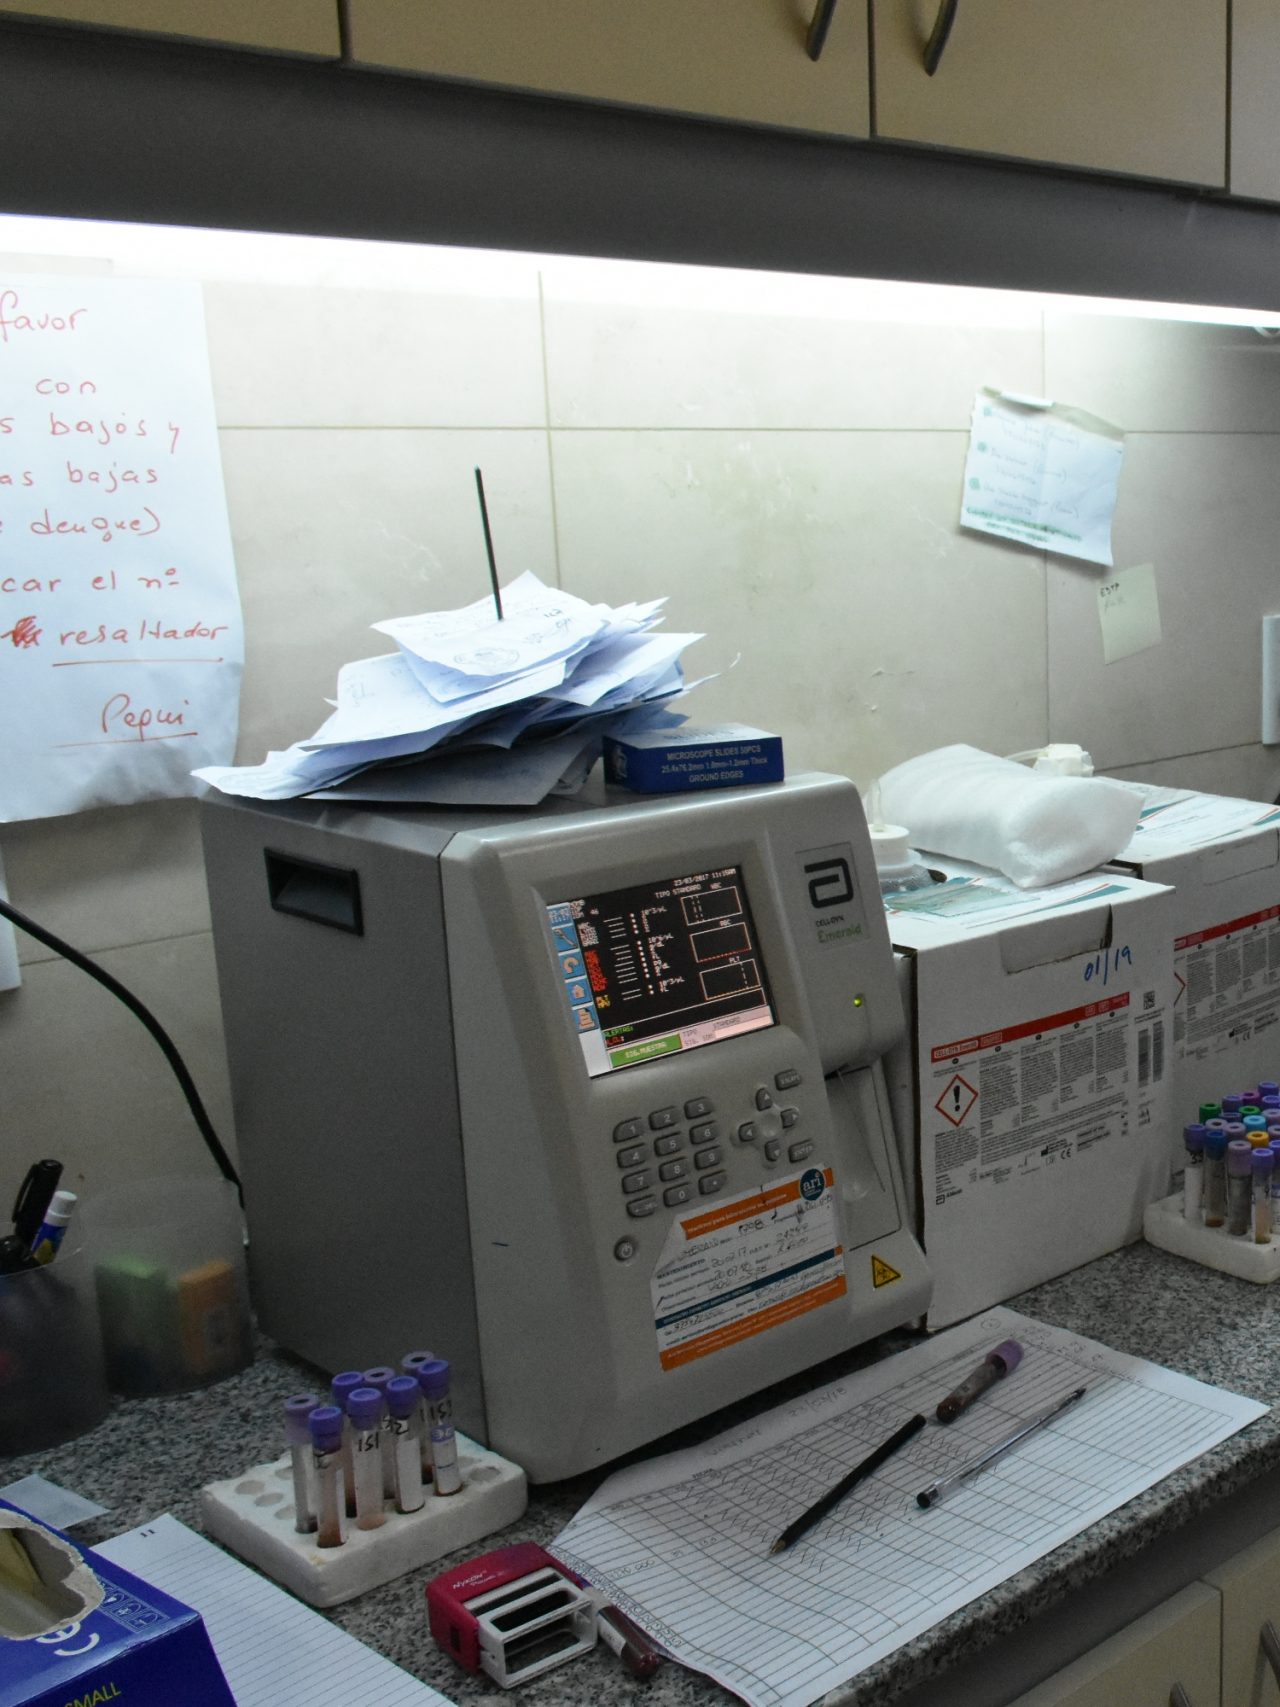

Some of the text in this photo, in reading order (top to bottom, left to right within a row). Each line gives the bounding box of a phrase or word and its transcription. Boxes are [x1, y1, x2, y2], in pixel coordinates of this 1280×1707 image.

[36, 379, 96, 395] con
[50, 413, 147, 444] bajos
[168, 422, 181, 453] y
[67, 461, 158, 493] bajas
[30, 508, 162, 542] dengue)
[92, 570, 116, 591] el
[59, 619, 228, 647] resaltador
[1084, 945, 1132, 985] 01/19
